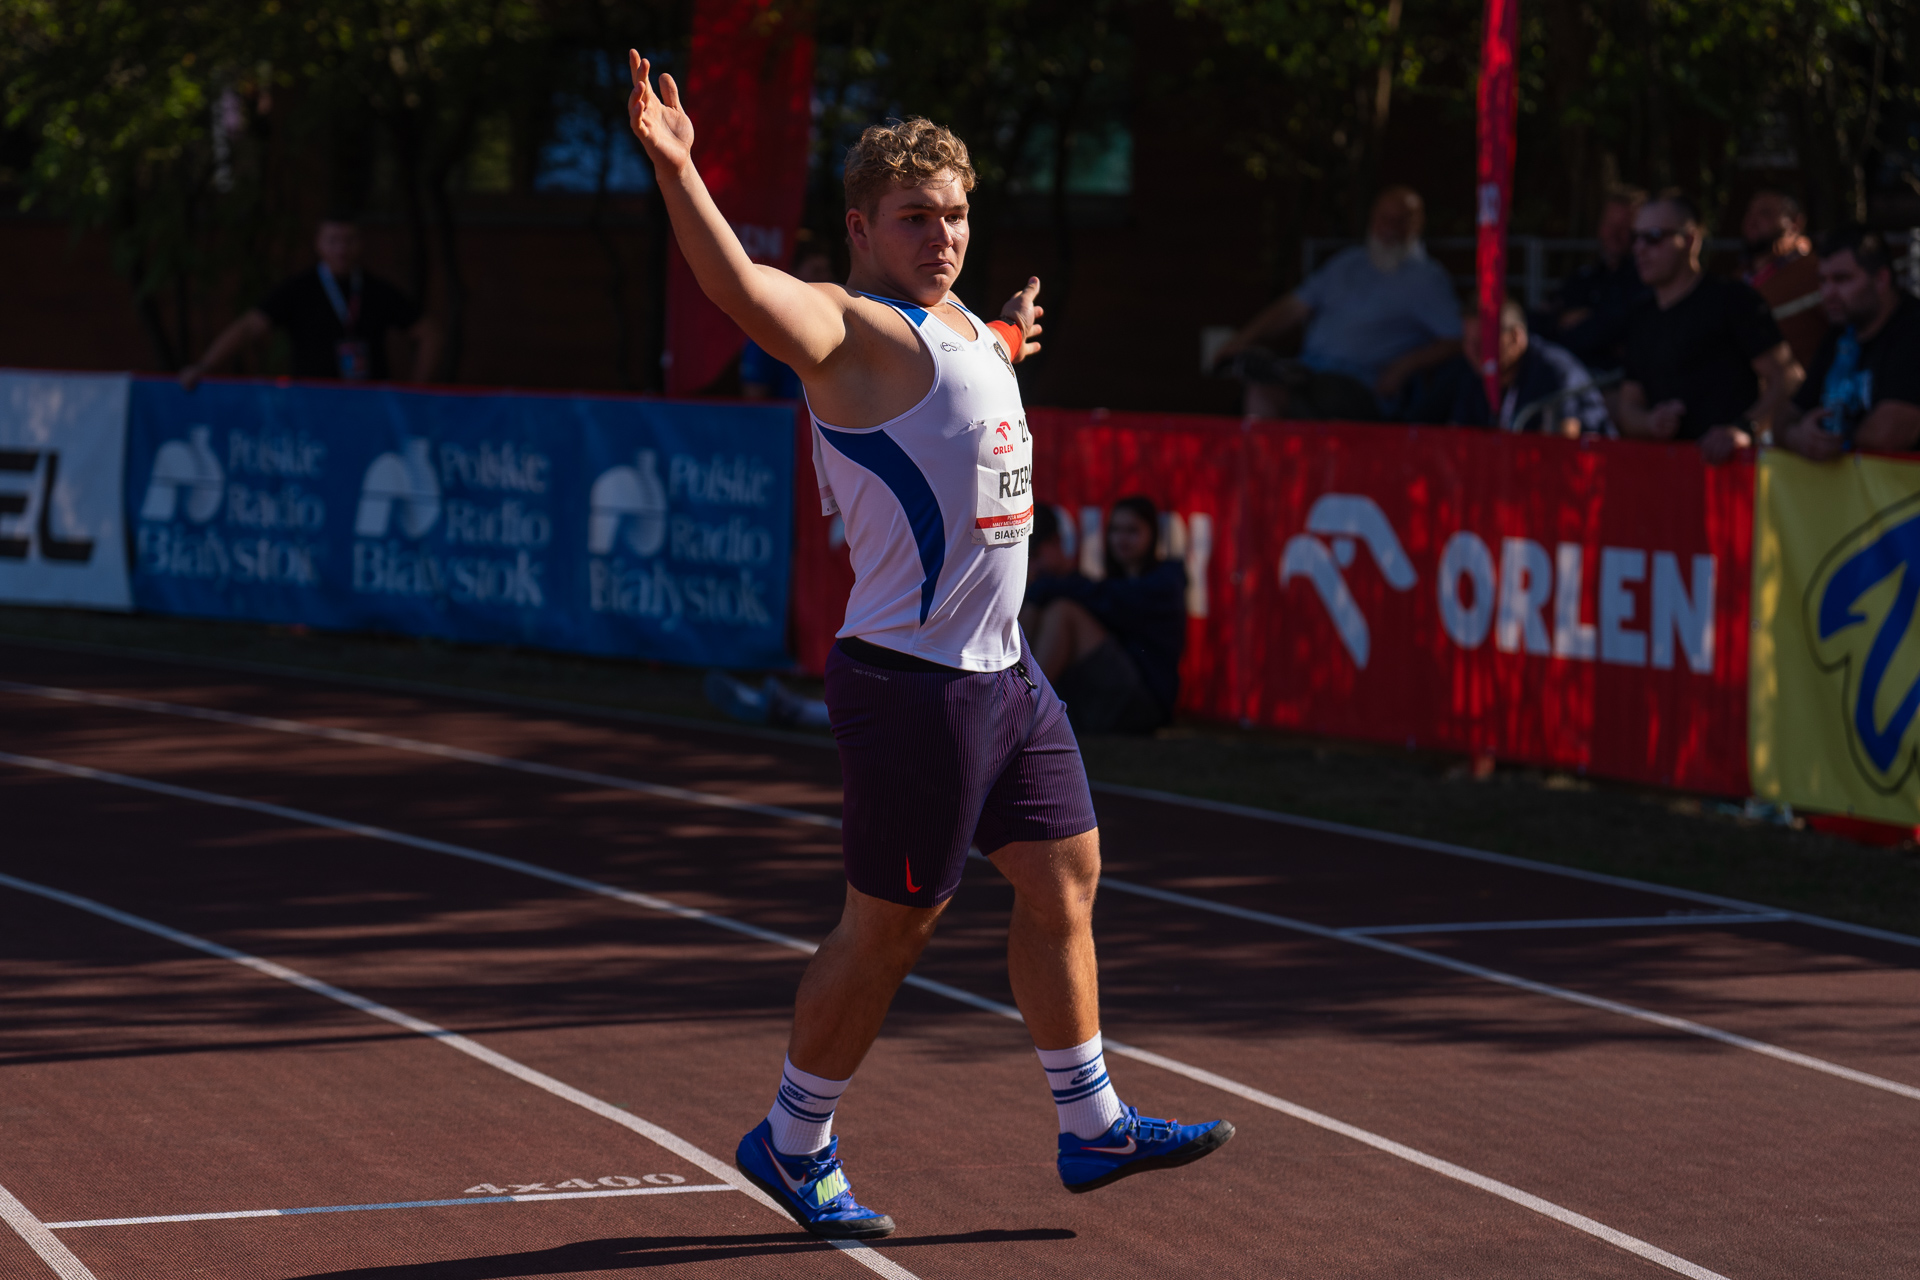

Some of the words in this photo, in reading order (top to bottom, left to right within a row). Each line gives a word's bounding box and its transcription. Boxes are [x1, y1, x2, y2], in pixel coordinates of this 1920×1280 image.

[439, 441, 550, 493] Polskie
[993, 443, 1014, 456] ORLEN
[669, 455, 773, 504] Polskie
[228, 483, 325, 528] Radio
[445, 499, 551, 545] Radio
[670, 517, 773, 563] Radio
[1438, 531, 1717, 674] ORLEN
[786, 1085, 808, 1101] NIKE
[1078, 1062, 1098, 1078] NIKE
